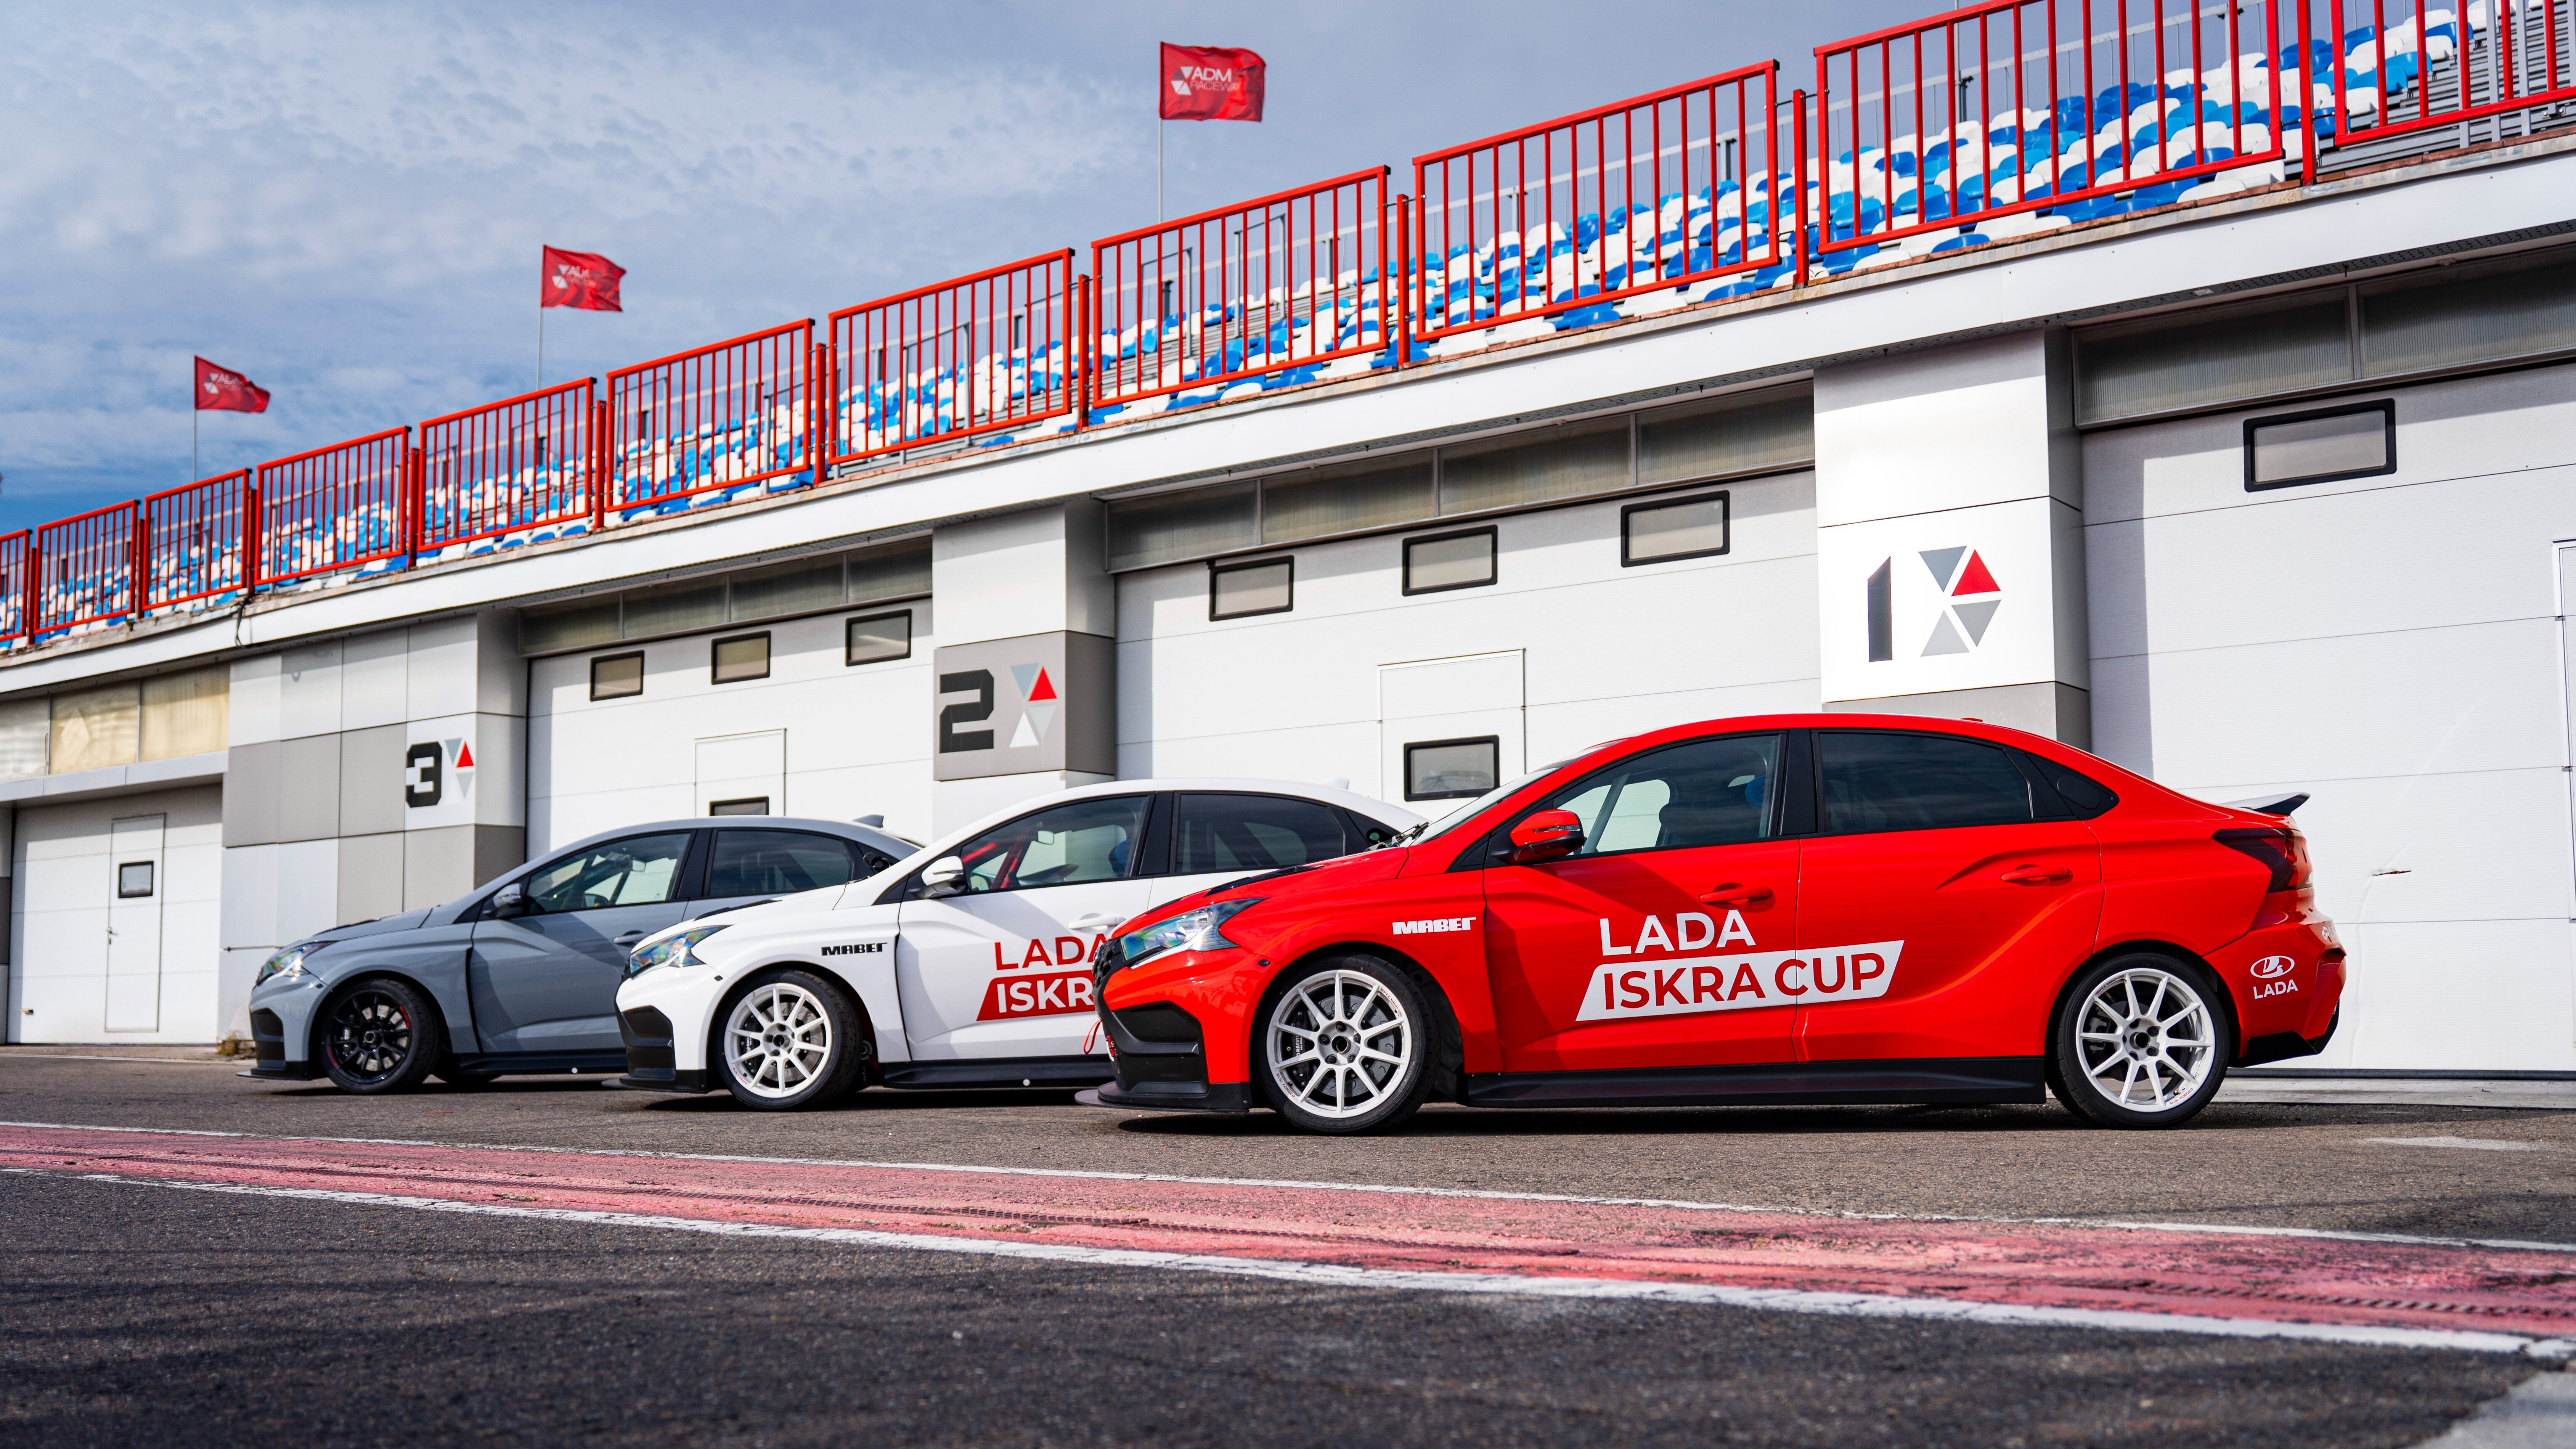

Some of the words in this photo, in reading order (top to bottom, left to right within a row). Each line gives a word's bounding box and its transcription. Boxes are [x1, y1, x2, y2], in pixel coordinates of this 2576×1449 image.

[1190, 80, 1241, 92] RACEW
[1191, 66, 1232, 82] ADM
[1868, 556, 1892, 662] 1
[940, 669, 994, 753] 2
[405, 741, 442, 808] 3
[1600, 909, 1756, 956] LADA
[1604, 963, 1766, 1010] ISKRA
[1775, 953, 1884, 996] CUP
[2253, 979, 2298, 999] LADA
[1282, 1083, 1295, 1097] FORGED
[2179, 1088, 2193, 1099] FORGED
